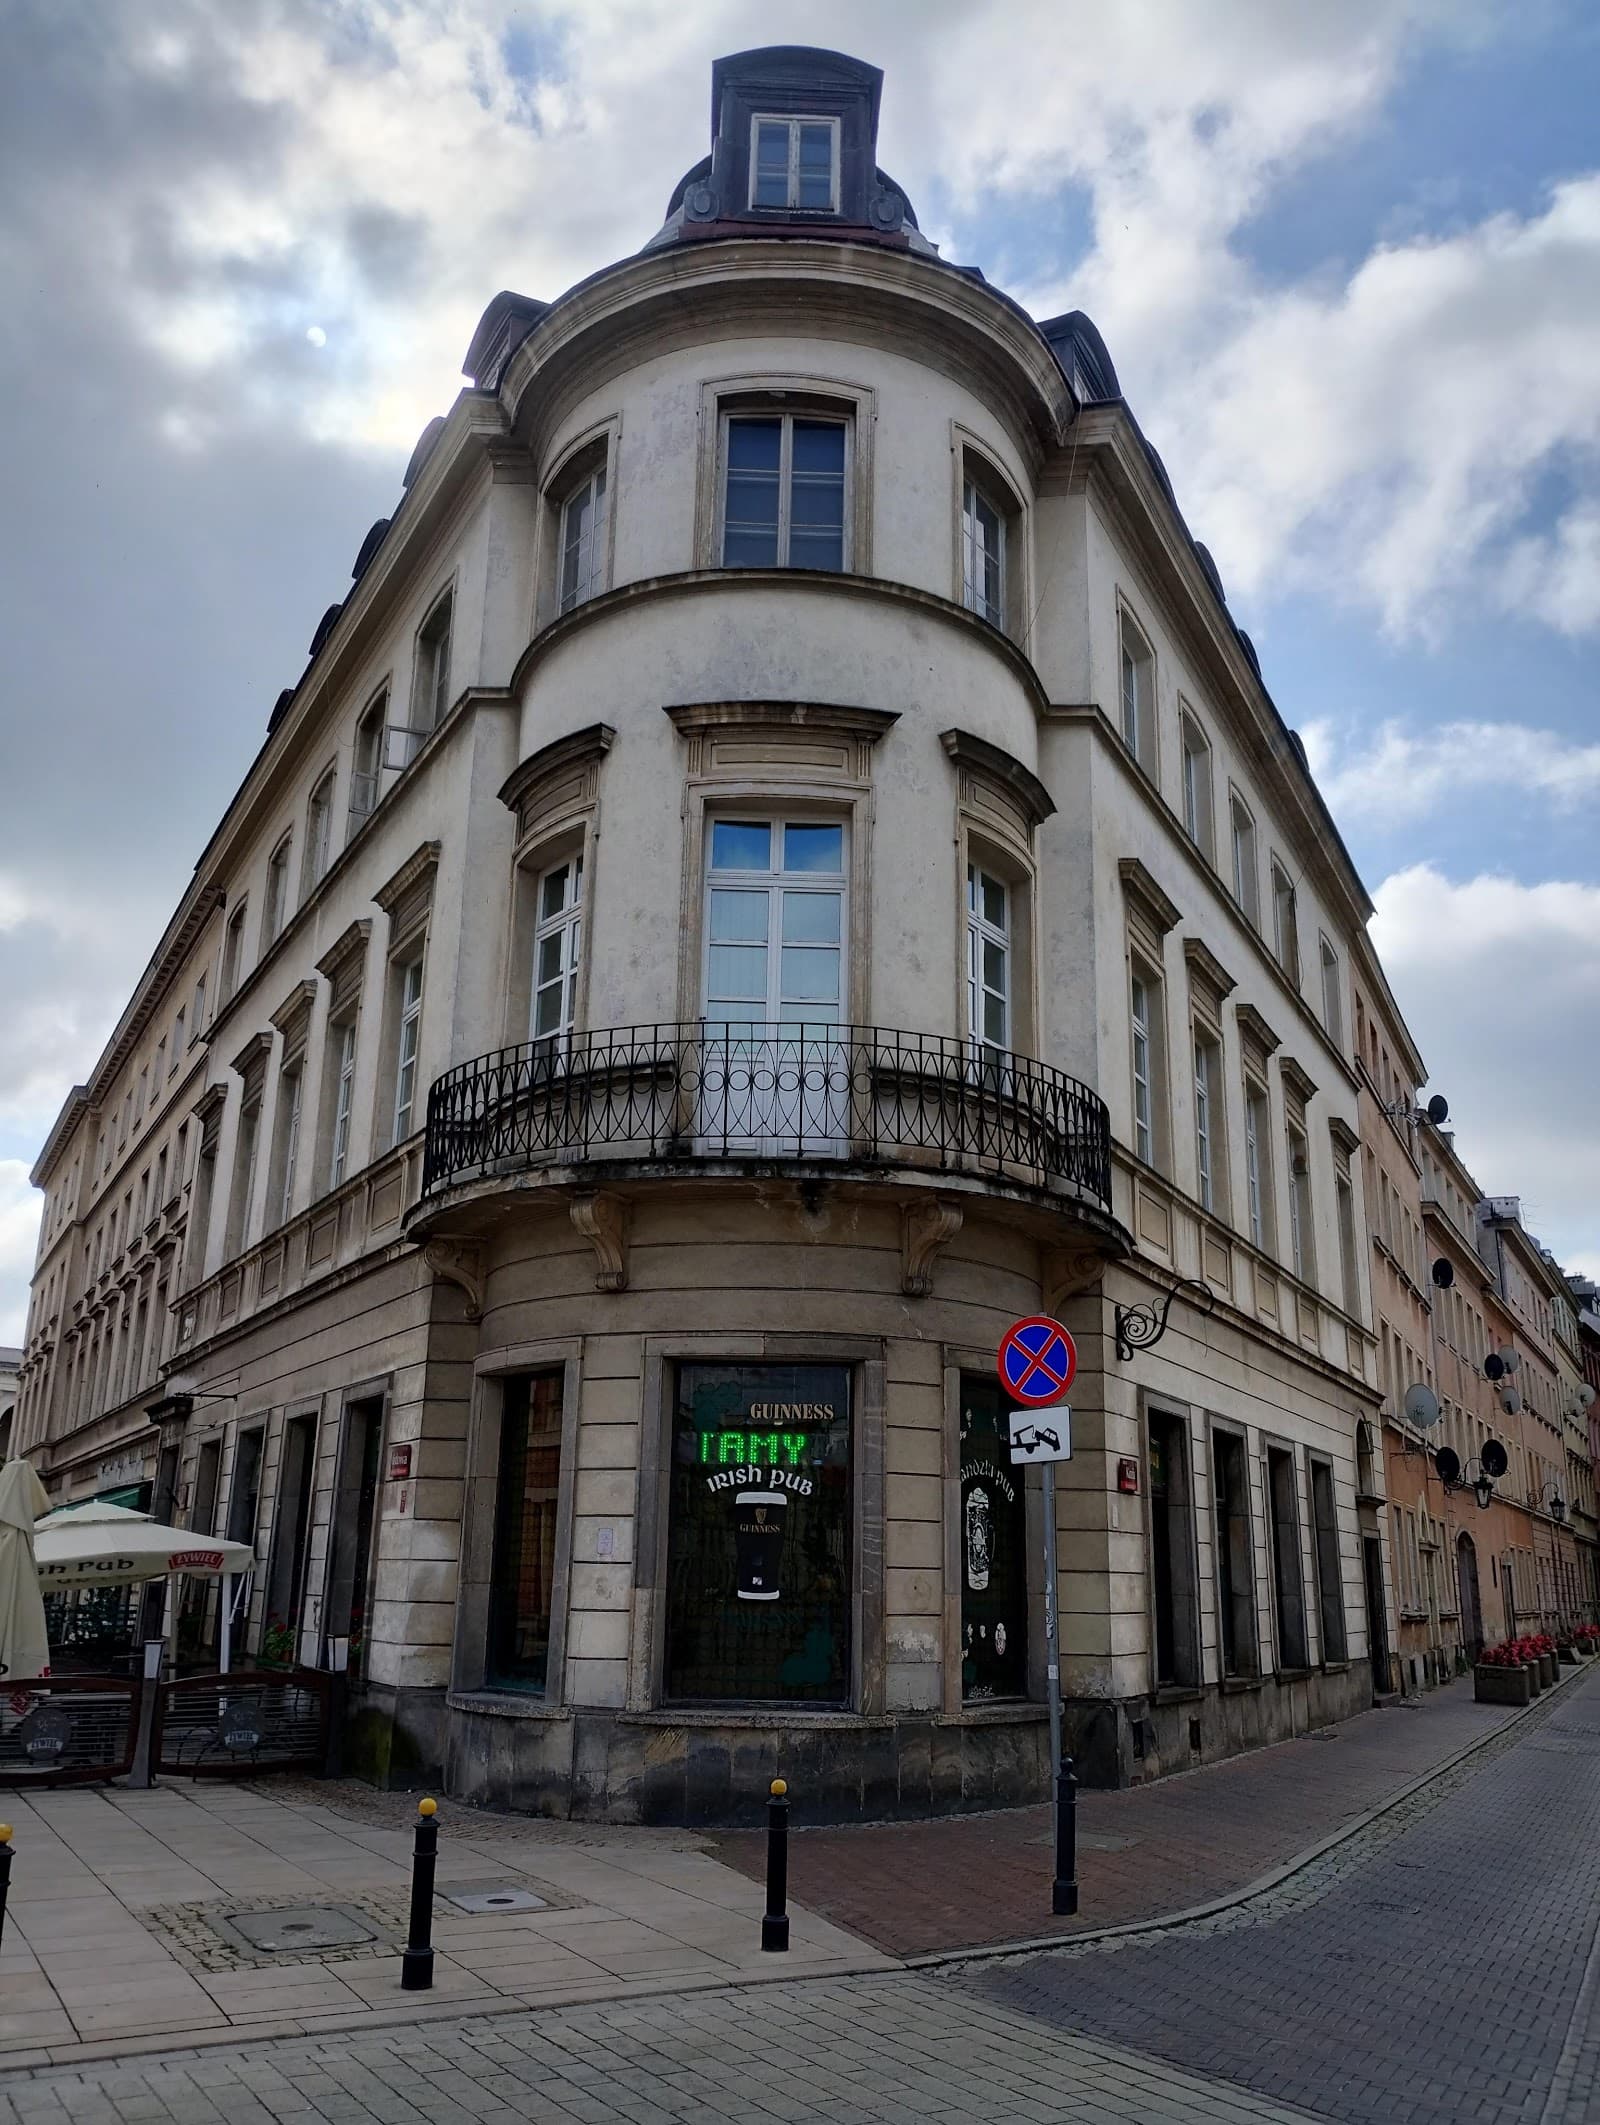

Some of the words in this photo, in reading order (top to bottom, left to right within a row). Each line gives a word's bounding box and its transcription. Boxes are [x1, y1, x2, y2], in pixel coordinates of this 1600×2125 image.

[751, 1403, 834, 1420] GUINNESS
[739, 1523, 781, 1534] GUINNESS
[78, 1558, 134, 1572] Pub
